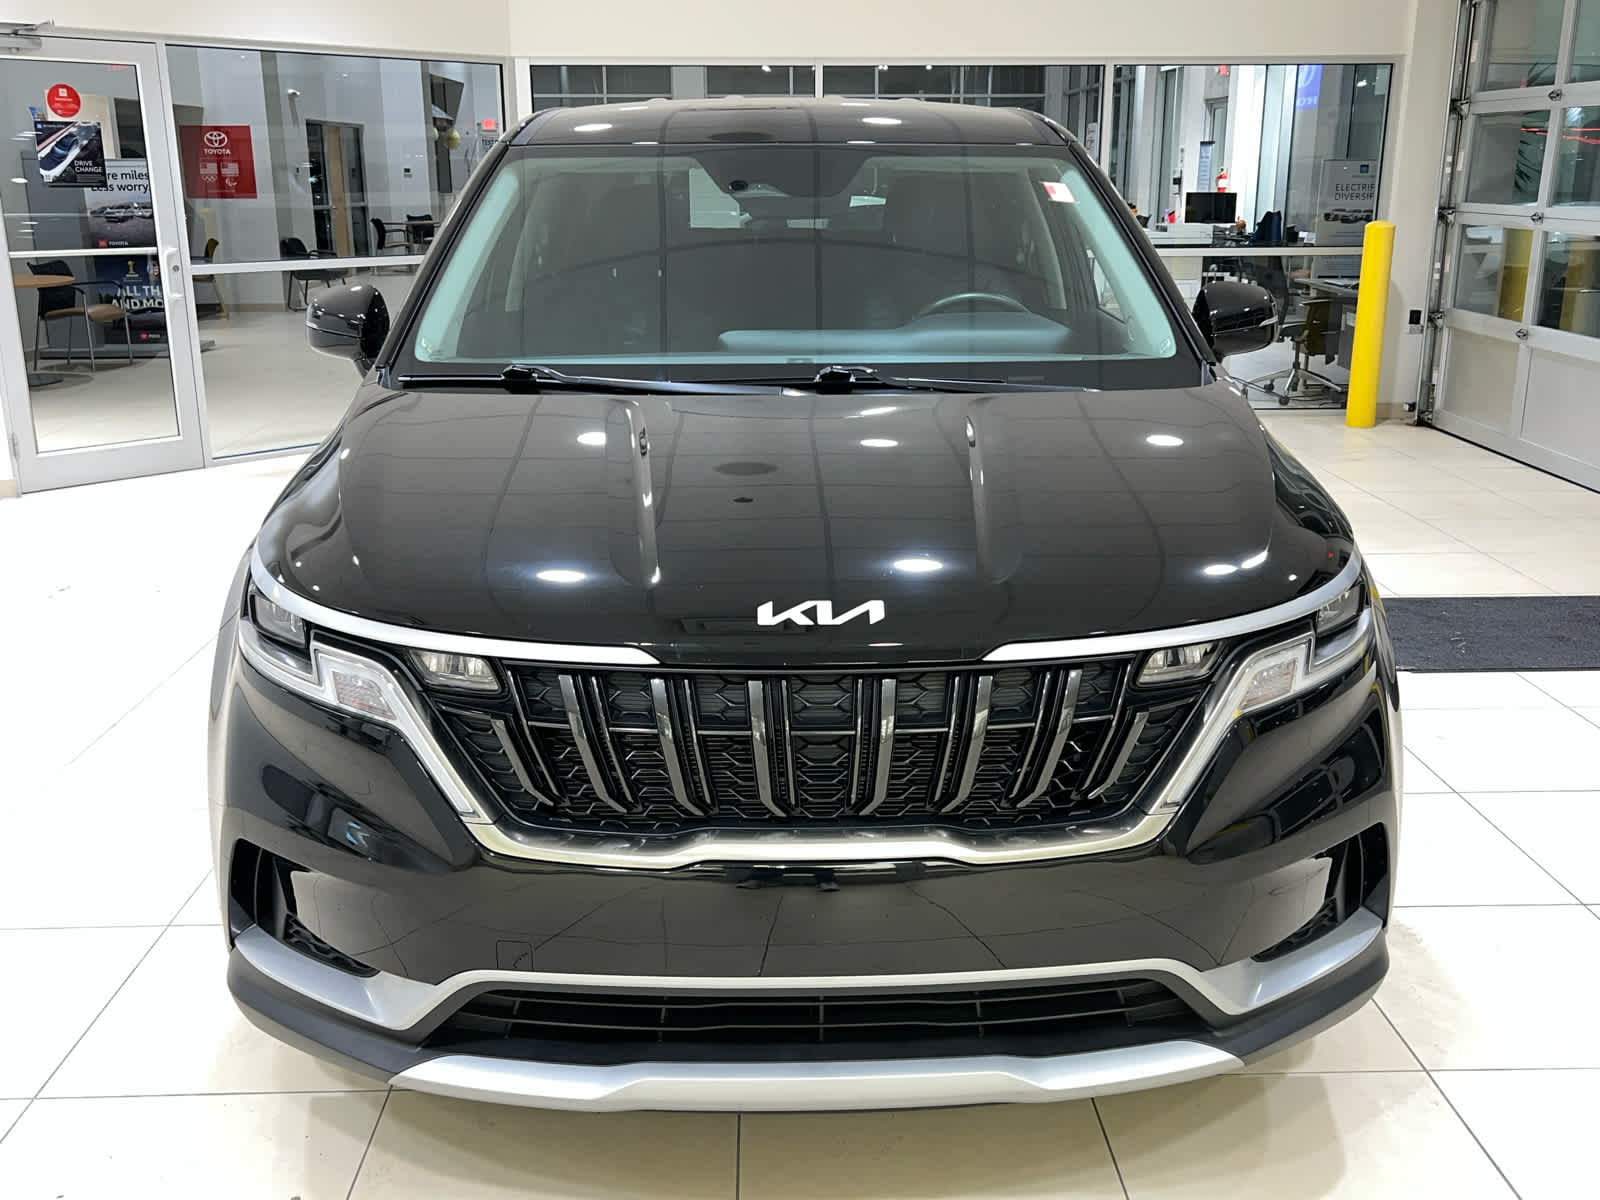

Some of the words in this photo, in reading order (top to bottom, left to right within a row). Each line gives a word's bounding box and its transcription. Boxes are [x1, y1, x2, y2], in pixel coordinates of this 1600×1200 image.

[107, 172, 118, 180] re
[1335, 183, 1376, 192] ELECTRIF
[1334, 192, 1375, 200] DIVERSIF
[117, 285, 141, 297] ALL
[142, 285, 161, 297] TH
[112, 299, 141, 310] AND
[143, 299, 164, 308] MO
[757, 600, 885, 625] KIA
